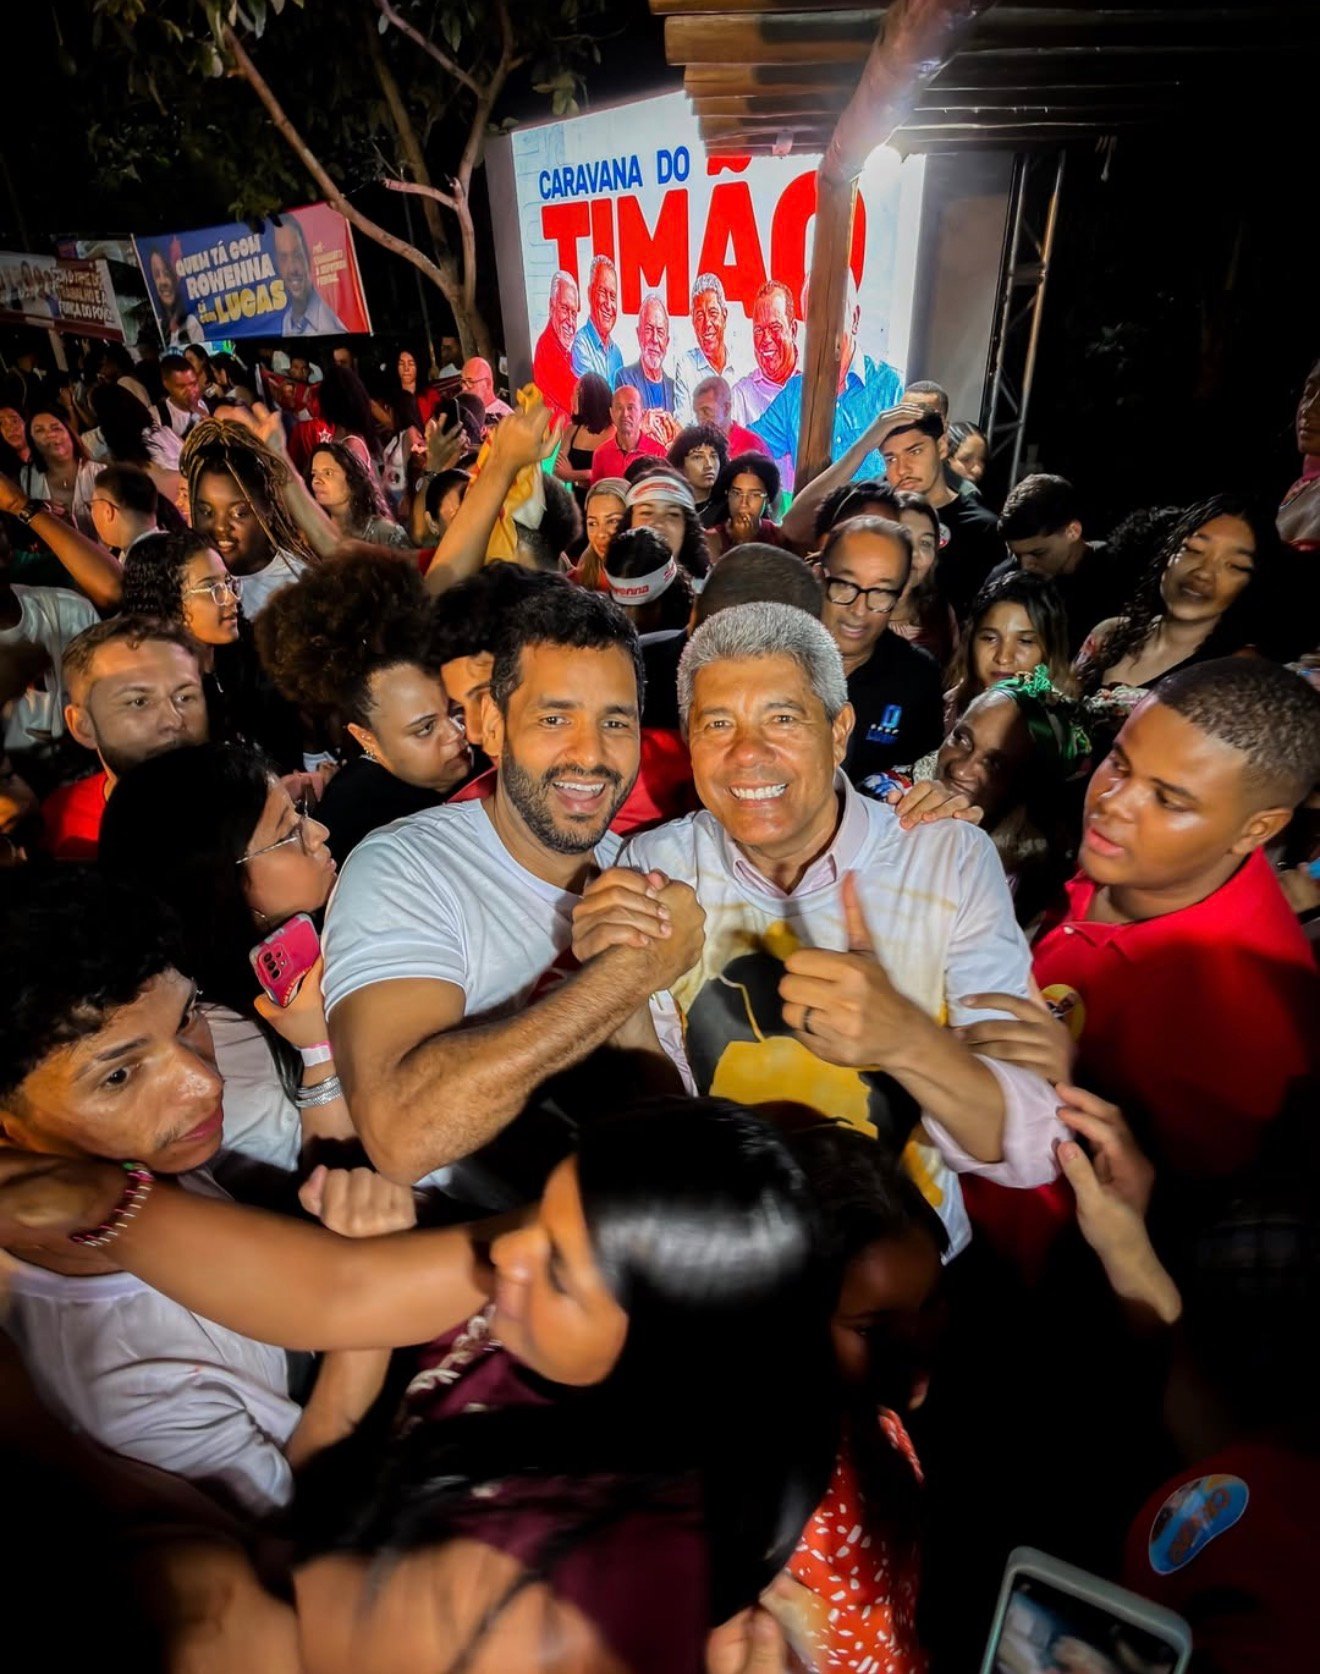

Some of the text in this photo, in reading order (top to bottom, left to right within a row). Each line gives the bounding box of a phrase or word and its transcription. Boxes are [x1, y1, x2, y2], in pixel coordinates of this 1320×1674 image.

[539, 146, 690, 200] CARAVANA DO
[175, 233, 262, 277] QUEM TÁ COM
[541, 155, 867, 321] TIMÃO
[186, 253, 277, 300] ROWENNA
[214, 279, 287, 325] LUCAS
